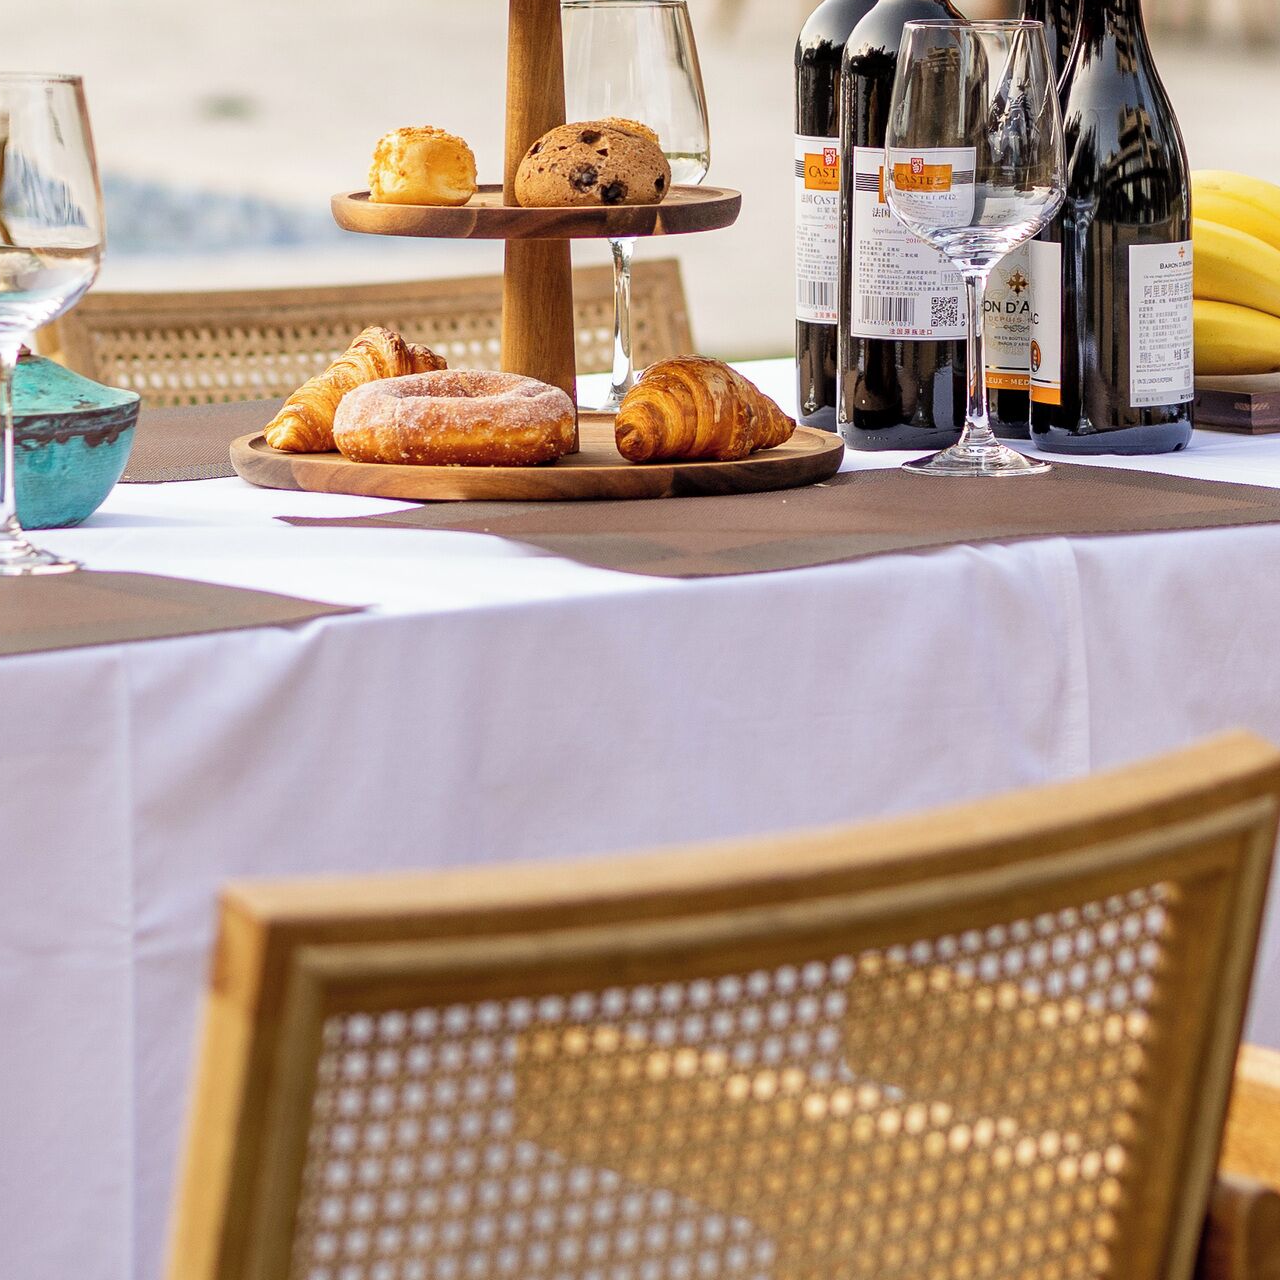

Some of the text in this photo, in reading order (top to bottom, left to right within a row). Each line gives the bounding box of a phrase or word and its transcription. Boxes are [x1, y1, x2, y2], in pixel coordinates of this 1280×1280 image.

[808, 165, 838, 178] CAST
[813, 194, 838, 205] CAST
[982, 300, 1001, 313] ON
